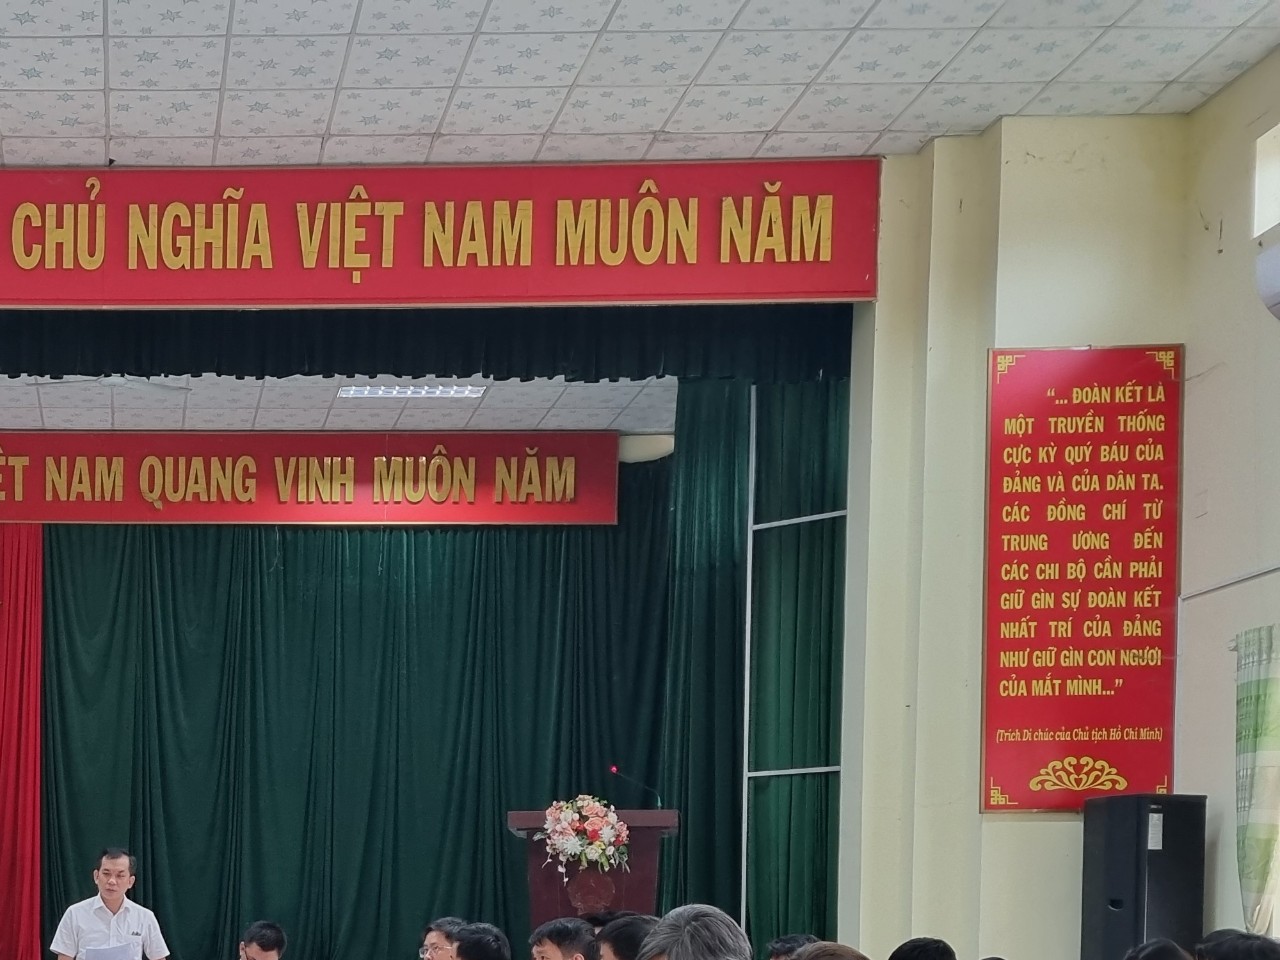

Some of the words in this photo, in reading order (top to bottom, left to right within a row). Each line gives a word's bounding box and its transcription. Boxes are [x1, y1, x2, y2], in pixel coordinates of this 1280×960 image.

[12, 177, 105, 270] CHỦ
[129, 187, 273, 270] NGHĨA
[296, 185, 403, 283] VIỆT
[424, 200, 532, 268] NAM
[556, 179, 698, 266] MUÔN
[720, 181, 832, 264] NĂM
[1073, 383, 1110, 403] ĐOÀN
[1116, 380, 1143, 402] KẾT
[1148, 382, 1165, 402] LÀ
[1005, 414, 1034, 437] MỘT
[1049, 409, 1104, 433] TRUYỀN
[1118, 409, 1164, 432] THỐNG
[1004, 444, 1031, 467] CỰC
[1039, 442, 1057, 463] KỲ
[1065, 441, 1092, 465] QUÝ
[1101, 441, 1129, 462] BÁU
[1136, 438, 1164, 461] CỦA
[45, 455, 124, 502] NAM
[140, 455, 257, 510] QUANG
[275, 456, 354, 504] VINH
[373, 444, 475, 503] MUÔN
[495, 447, 575, 503] NĂM
[1003, 470, 1041, 493] ĐẢNG
[1047, 471, 1064, 492] VÀ
[1072, 469, 1100, 491] CỦA
[1107, 470, 1135, 491] DÂN
[1142, 474, 1163, 490] TA.
[1003, 501, 1030, 522] CÁC
[1047, 498, 1085, 521] ĐỒNG
[1103, 500, 1127, 520] CHÍ
[1143, 499, 1163, 519] TỪ
[1002, 534, 1048, 551] TRUNG
[1073, 531, 1109, 549] ƯƠNG
[1134, 526, 1162, 549] ĐẾN
[1002, 560, 1029, 580] CÁC
[1036, 563, 1059, 579] CHI
[1067, 559, 1086, 582] BỘ
[1094, 555, 1122, 579] CẦN
[1130, 556, 1162, 578] PHẢI
[1001, 590, 1025, 610] GIỮ
[1032, 589, 1054, 608] GÌN
[1062, 589, 1081, 611] SỰ
[1088, 587, 1126, 607] ĐOÀN
[1134, 585, 1161, 607] KẾT
[1001, 616, 1037, 638] NHẤT
[1049, 617, 1071, 637] TRÍ
[1084, 614, 1111, 637] CỦA
[1123, 614, 1161, 637] ĐẢNG
[1000, 649, 1029, 667] NHƯ
[1033, 647, 1057, 667] GIỮ
[1061, 646, 1083, 666] GÌN
[1088, 650, 1115, 666] CON
[1121, 647, 1161, 666] NGƯƠI
[1000, 674, 1027, 696] CỦA
[1032, 673, 1061, 696] MẮT
